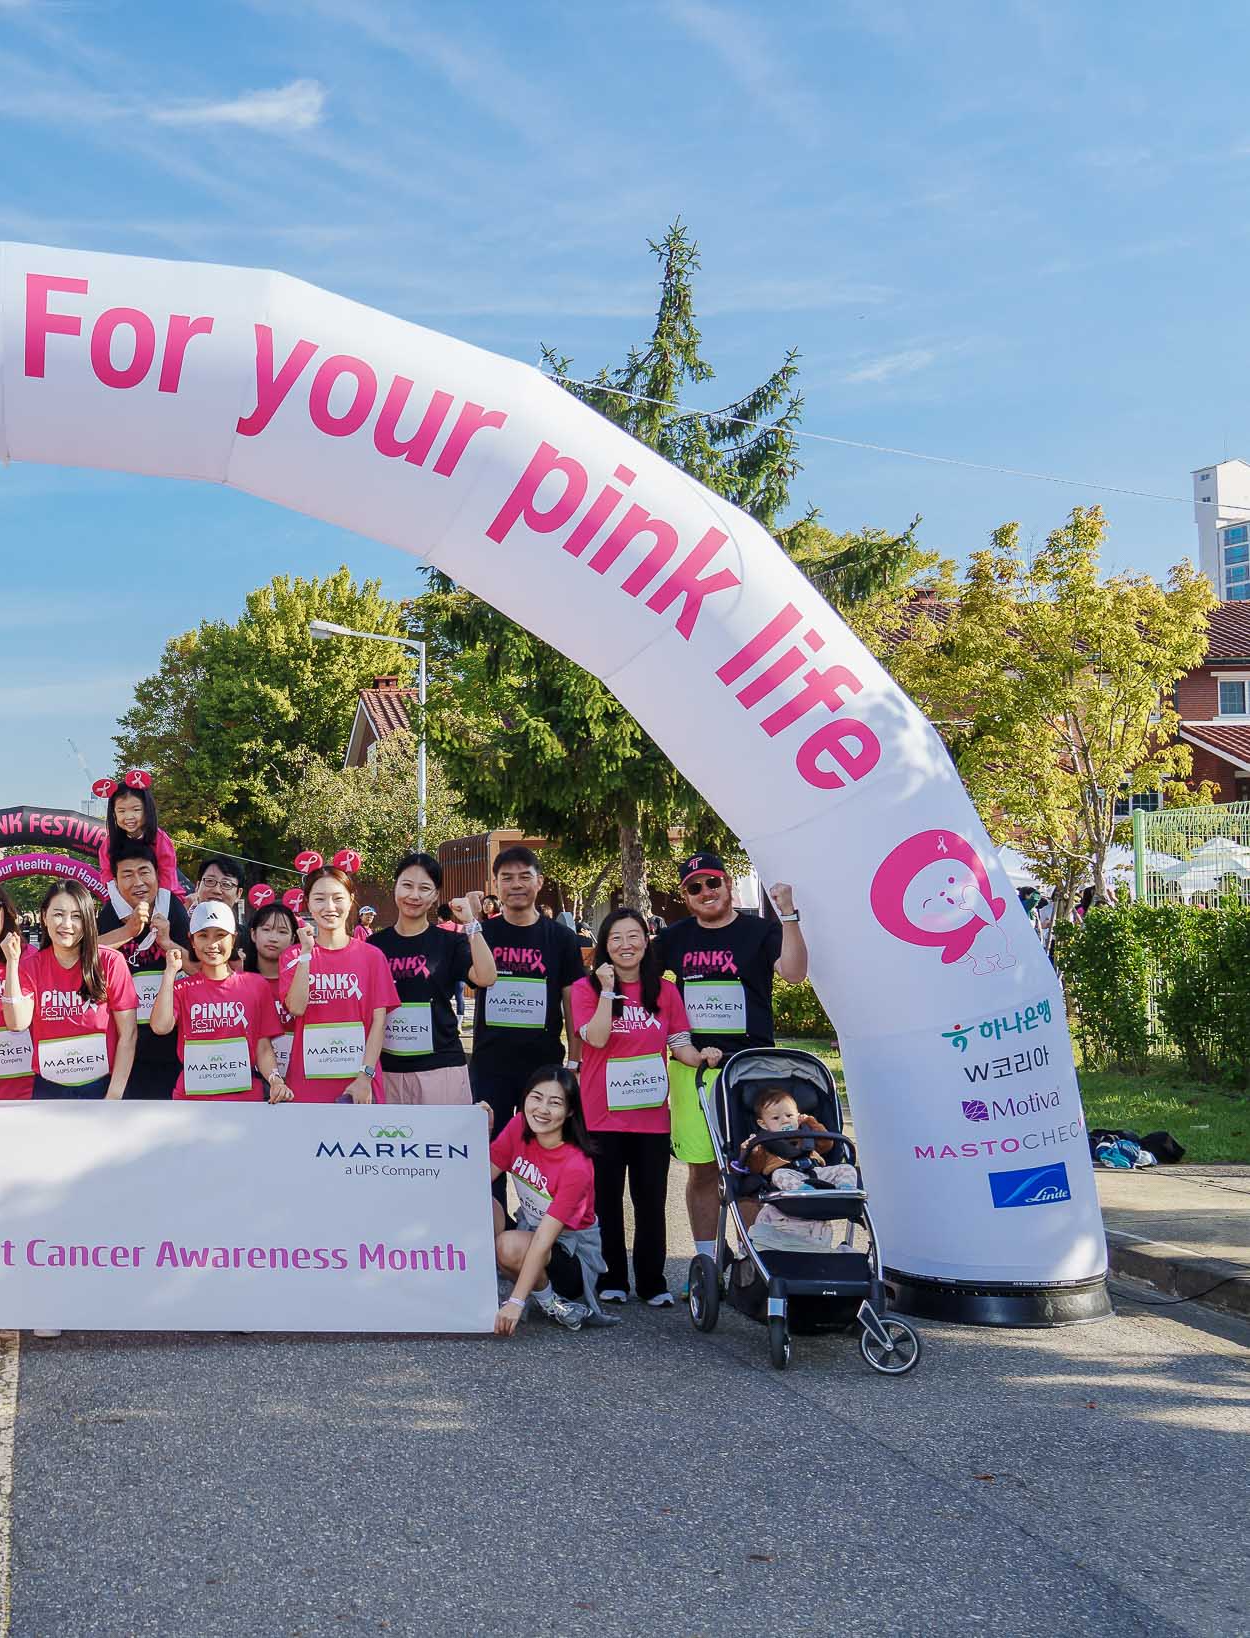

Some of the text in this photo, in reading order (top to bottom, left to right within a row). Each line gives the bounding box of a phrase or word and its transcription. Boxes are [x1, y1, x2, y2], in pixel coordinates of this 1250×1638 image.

[24, 273, 214, 394] For
[236, 323, 508, 478] your
[485, 440, 741, 642] pink
[715, 602, 882, 790] life
[30, 813, 110, 849] FESTIVA
[15, 858, 52, 872] Health
[54, 862, 76, 877] and
[77, 867, 111, 899] Happin
[309, 989, 348, 1000] ESTIVAL
[488, 998, 544, 1007] MARKEN
[687, 1003, 743, 1011] MARKEN
[41, 1006, 84, 1017] FESTIVAL
[191, 1018, 234, 1030] FESTIVAL
[612, 1019, 646, 1030] ESTIVAL
[979, 999, 1052, 1040] 하나은행
[385, 1025, 429, 1033] ARKEN
[306, 1045, 364, 1055] MARKEN
[43, 1054, 105, 1069] MARKEN
[187, 1060, 247, 1071] MARKEN
[963, 1045, 1050, 1083] W코리아
[213, 1072, 237, 1080] Company
[610, 1075, 666, 1087] MARKEN
[992, 1091, 1061, 1120] Motiva
[315, 1140, 469, 1160] MARKEN
[345, 1164, 440, 1180] a UPS Company
[1025, 1186, 1069, 1204] Linde
[26, 1239, 145, 1268] Cancer
[156, 1240, 349, 1270] Awareness
[359, 1242, 467, 1272] Month
